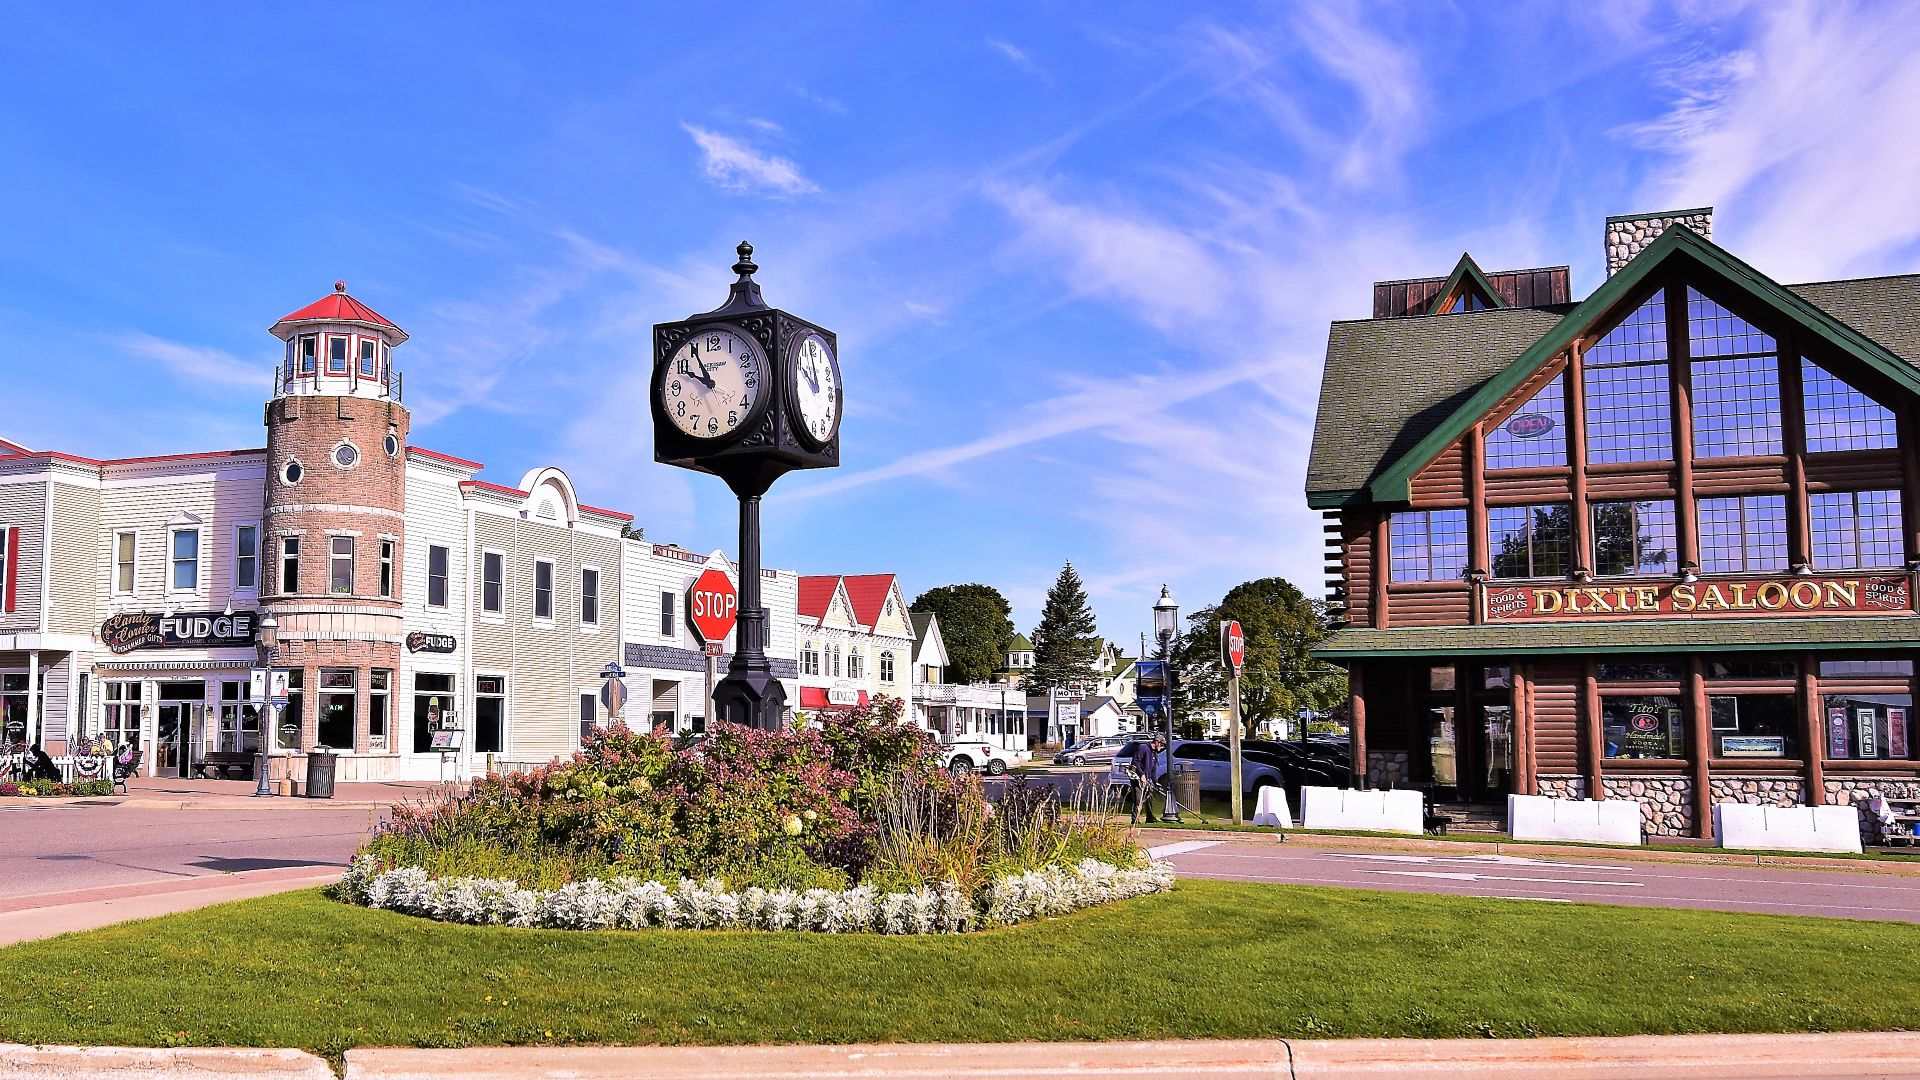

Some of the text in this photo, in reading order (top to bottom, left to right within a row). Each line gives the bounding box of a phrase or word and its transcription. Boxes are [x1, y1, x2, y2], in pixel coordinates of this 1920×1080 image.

[706, 336, 721, 353] 12
[727, 339, 732, 354] 1
[677, 359, 689, 375] 10
[740, 352, 751, 369] 2
[745, 371, 757, 388] 3
[671, 380, 682, 397] 9
[677, 401, 686, 417] 8
[739, 394, 750, 410] 4
[690, 414, 701, 430] 7
[707, 417, 719, 433] 6
[727, 411, 738, 426] 5
[1511, 418, 1549, 433] OPEN
[1490, 590, 1526, 604] FOOD &
[1532, 580, 1860, 614] DIXIE SALOON
[1864, 583, 1908, 595] FOOD &
[694, 590, 735, 619] STOP
[1865, 590, 1906, 605] SPIRITS
[1490, 600, 1528, 614] SPIRITS
[110, 612, 153, 630] Candy
[158, 616, 250, 639] FUDGE
[115, 623, 158, 643] Corner
[147, 633, 163, 643] GIFTS
[425, 636, 453, 648] FUDGE
[706, 644, 723, 655] 3-WAY
[1230, 635, 1243, 653] STOP
[1629, 703, 1661, 714] Tito's
[1625, 729, 1666, 740] Handmade
